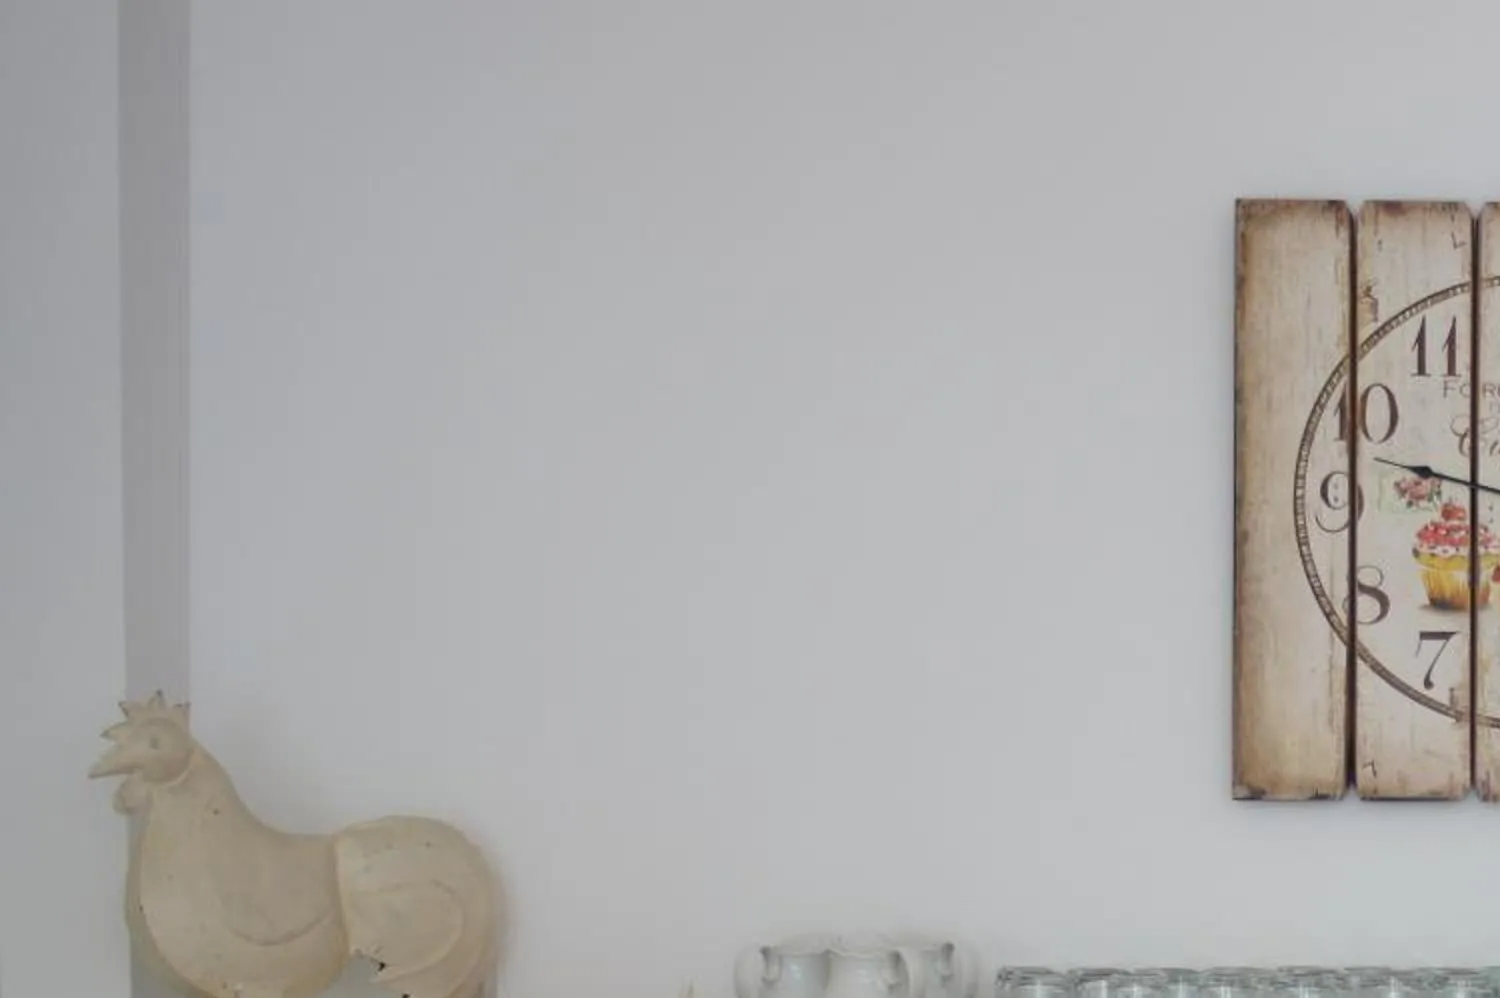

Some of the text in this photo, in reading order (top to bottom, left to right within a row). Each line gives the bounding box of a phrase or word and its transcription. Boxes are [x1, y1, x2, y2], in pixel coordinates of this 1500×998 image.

[1410, 315, 1461, 377] 11
[1333, 383, 1399, 444] 10
[1315, 470, 1364, 533] 9
[1342, 564, 1391, 626] 8
[1415, 630, 1461, 690] 7
